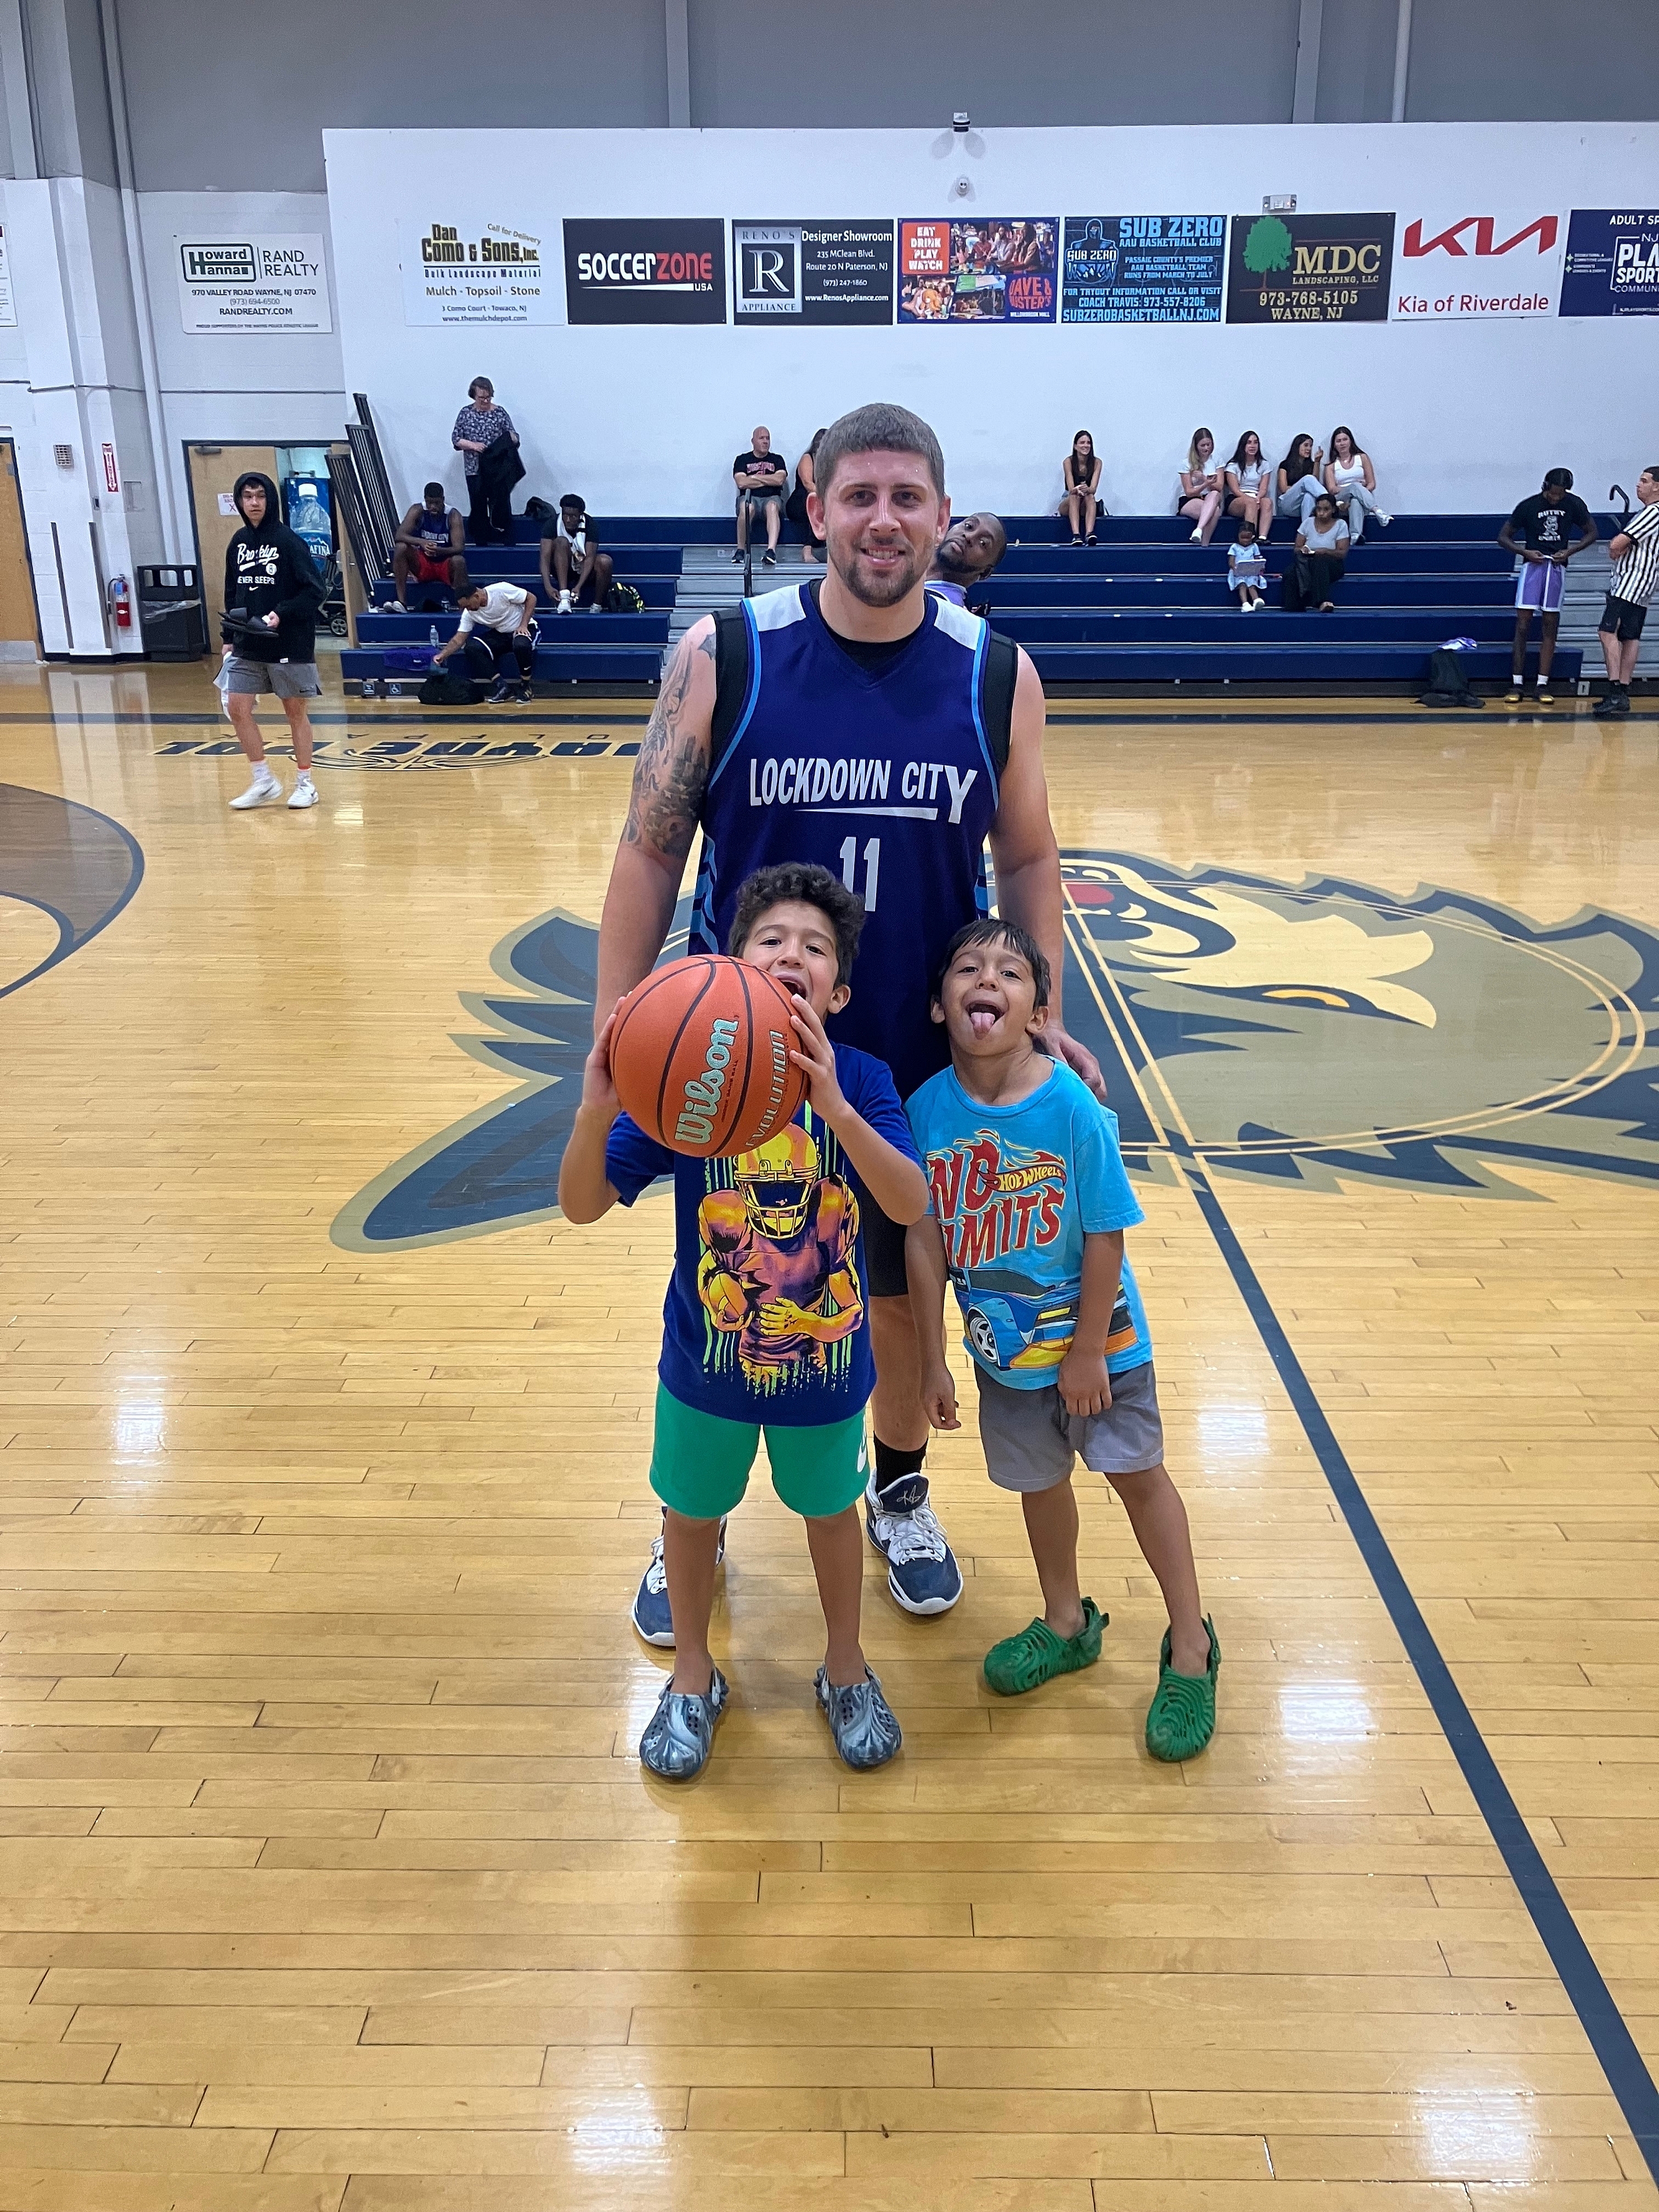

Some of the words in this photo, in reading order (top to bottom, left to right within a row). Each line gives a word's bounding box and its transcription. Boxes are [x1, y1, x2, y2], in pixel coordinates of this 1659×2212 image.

[1610, 215, 1645, 224] ADULT
[432, 224, 457, 240] Dan
[917, 226, 935, 236] EAT
[1119, 217, 1162, 238] SUB
[1168, 217, 1223, 238] ZERO
[488, 223, 500, 232] Call
[502, 226, 512, 236] for
[513, 230, 541, 246] Delivery
[802, 230, 842, 244] Designer
[844, 230, 892, 241] Showroom
[1403, 216, 1558, 256] KIA
[1641, 233, 1658, 242] NJ
[911, 238, 941, 247] DRINK
[1119, 239, 1137, 247] AAU
[1139, 238, 1198, 247] BASKETBALL
[1199, 238, 1222, 246] CLUB
[263, 250, 304, 262] RAND
[422, 238, 465, 262] Como
[469, 244, 477, 262] &
[858, 250, 875, 258] Blvd.
[914, 249, 938, 259] PLAY
[1068, 250, 1087, 262] SUB
[1090, 250, 1116, 262] ZERO
[909, 260, 943, 270] WATCH
[1293, 245, 1381, 274] MDC
[265, 264, 319, 276] REALTY
[749, 250, 789, 292] R
[806, 262, 826, 270] Route
[845, 262, 877, 272] Paterson,
[879, 263, 888, 272] NJ
[425, 269, 445, 278] Bulk
[449, 269, 496, 279] Landscape
[501, 269, 540, 278] Material
[1293, 276, 1359, 285] LANDSCAPING,
[1362, 275, 1379, 283] LLC
[823, 279, 838, 287] (973)
[426, 286, 456, 296] Mulch
[465, 286, 502, 298] Topsoil
[511, 286, 540, 296] Stone
[1063, 288, 1078, 296] FOR
[1080, 288, 1110, 296] TRYOUT
[1112, 287, 1166, 296] INFORMATION
[1200, 287, 1222, 295] VISIT
[805, 294, 889, 302] www.RenosAppliance.com
[1079, 298, 1105, 307] COACH
[1108, 297, 1142, 307] TRAVIS:
[1144, 297, 1206, 307] 973-557-8206
[1260, 290, 1358, 306] 973-768-5105
[1399, 296, 1427, 313] Kia
[1434, 295, 1455, 312] of
[1460, 293, 1549, 312] Riverdale
[742, 303, 795, 311] APPLIANCE
[1063, 308, 1219, 321] SUBZEROBASKETBALLNJ.COM
[1271, 307, 1323, 320] WAYNE,
[1327, 307, 1344, 319] NJ
[238, 576, 253, 584] EVER
[255, 576, 275, 585] SEEPS
[750, 758, 891, 806] LOCKDOWN
[901, 761, 978, 824] CITY
[839, 836, 880, 912] 11
[675, 1018, 739, 1144] Wilson
[927, 1138, 1001, 1221] NO
[941, 1186, 1066, 1268] IMITS
